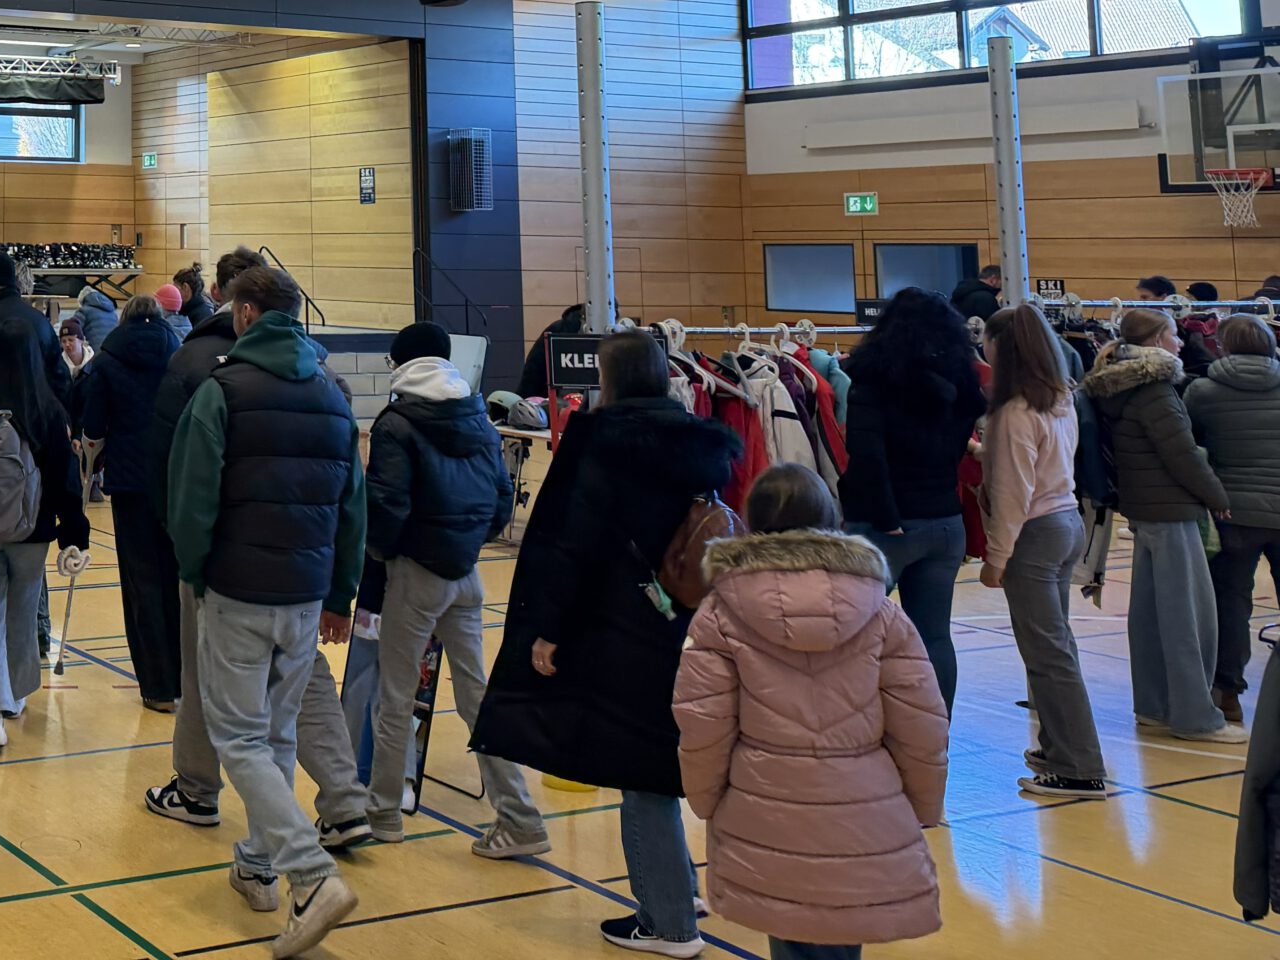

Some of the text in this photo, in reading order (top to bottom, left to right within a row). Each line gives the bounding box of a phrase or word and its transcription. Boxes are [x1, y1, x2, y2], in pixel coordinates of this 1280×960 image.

[1039, 280, 1061, 290] SKI
[864, 307, 881, 316] HEL
[560, 353, 600, 368] KLEI
